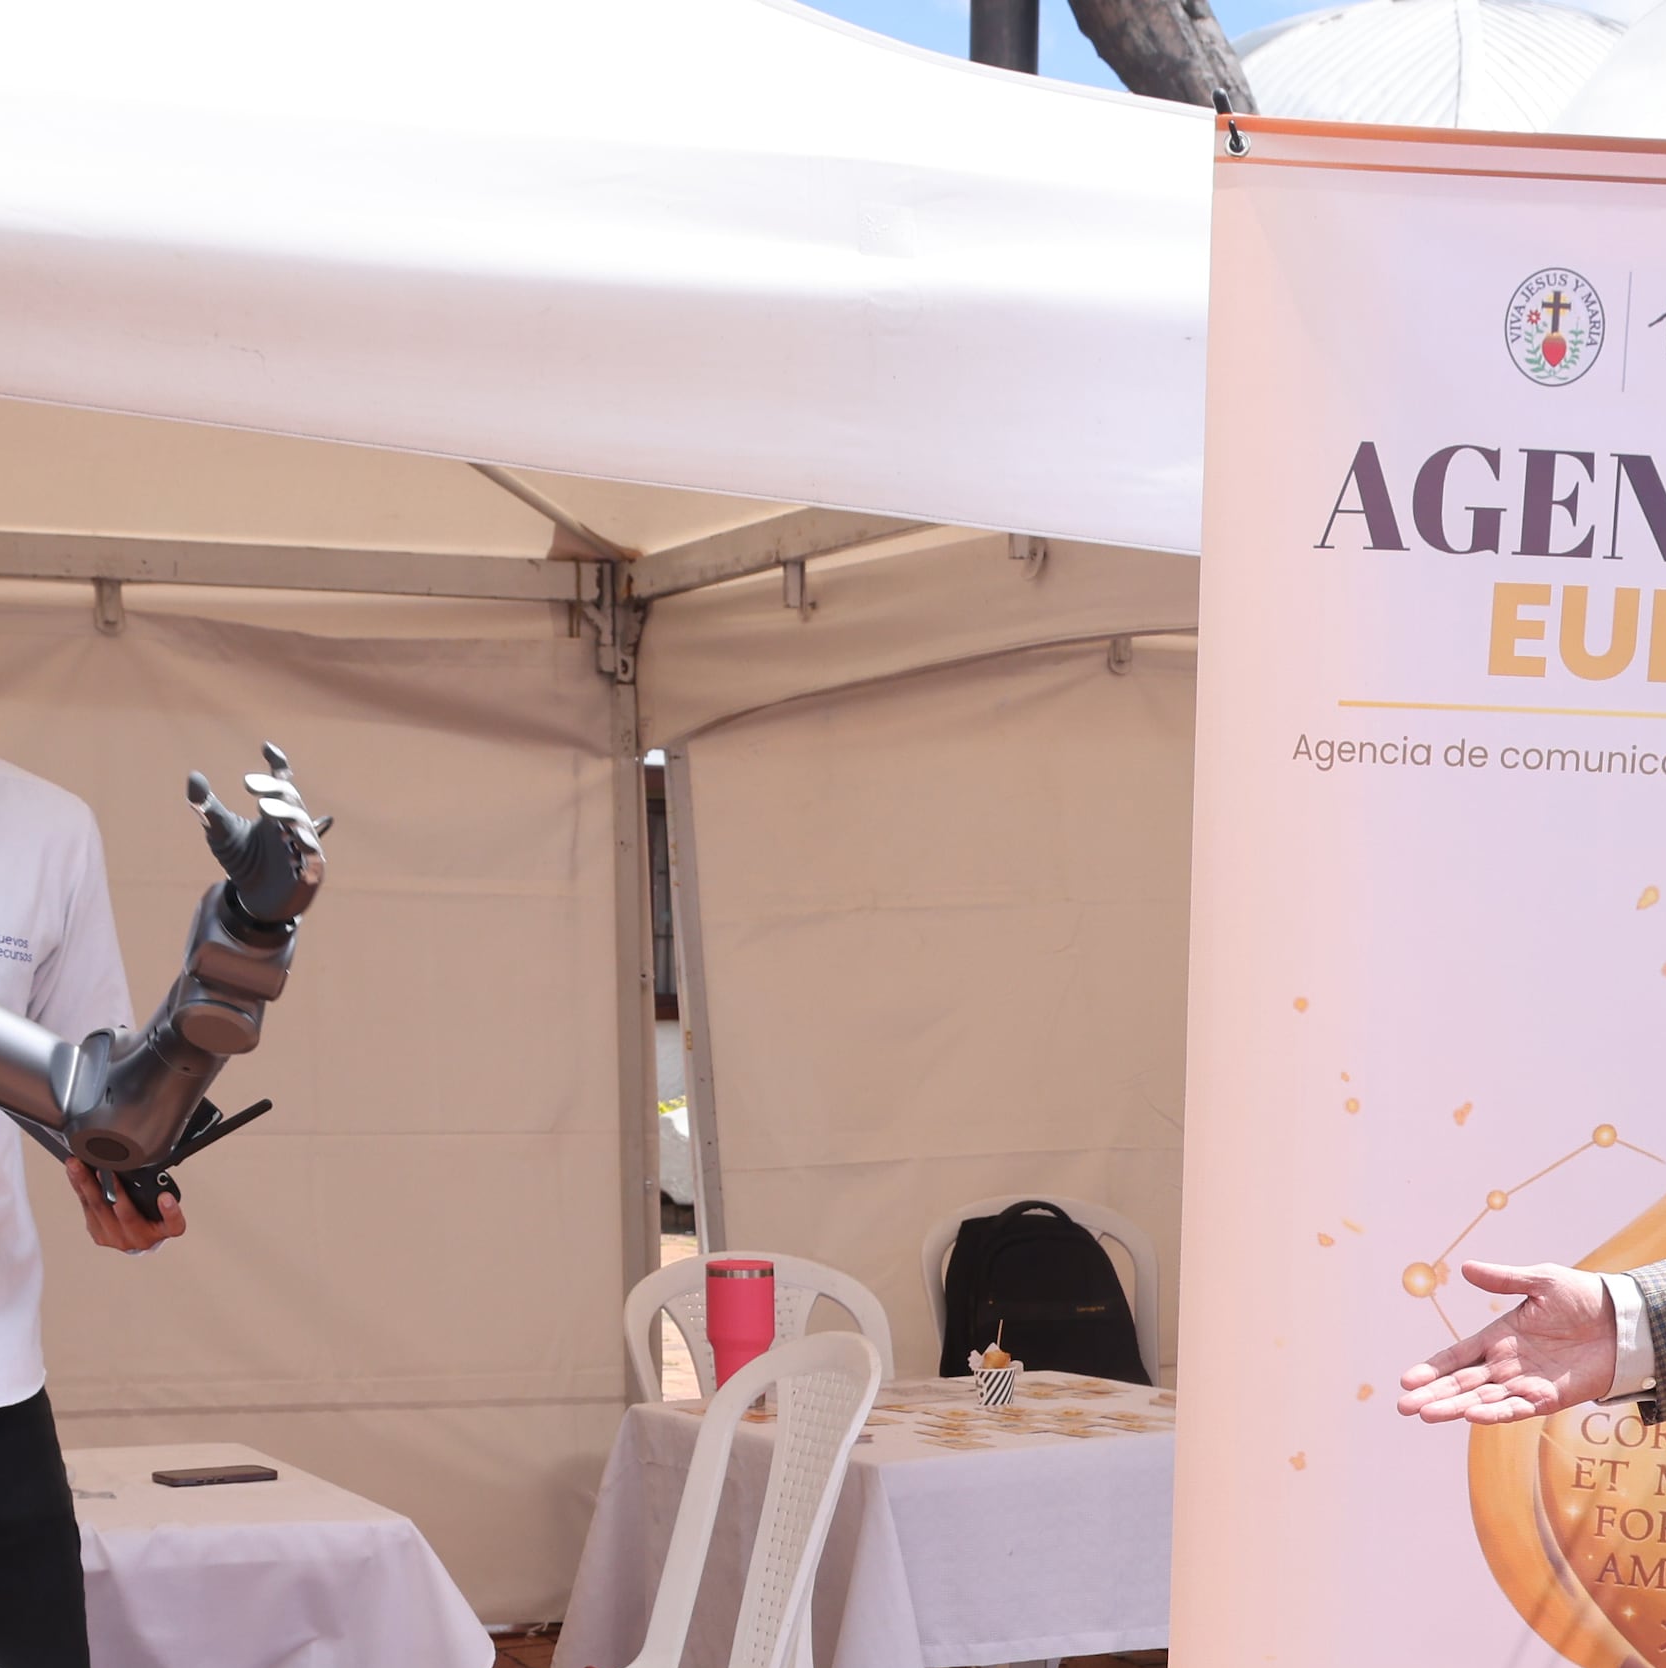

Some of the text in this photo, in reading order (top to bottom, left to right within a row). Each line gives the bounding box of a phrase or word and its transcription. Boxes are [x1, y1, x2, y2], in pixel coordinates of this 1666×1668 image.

[1510, 304, 1526, 343] VIVA
[1572, 279, 1585, 293] Y
[1292, 734, 1432, 771] Agencia
[1443, 738, 1489, 768] de
[1573, 1457, 1630, 1493] ET
